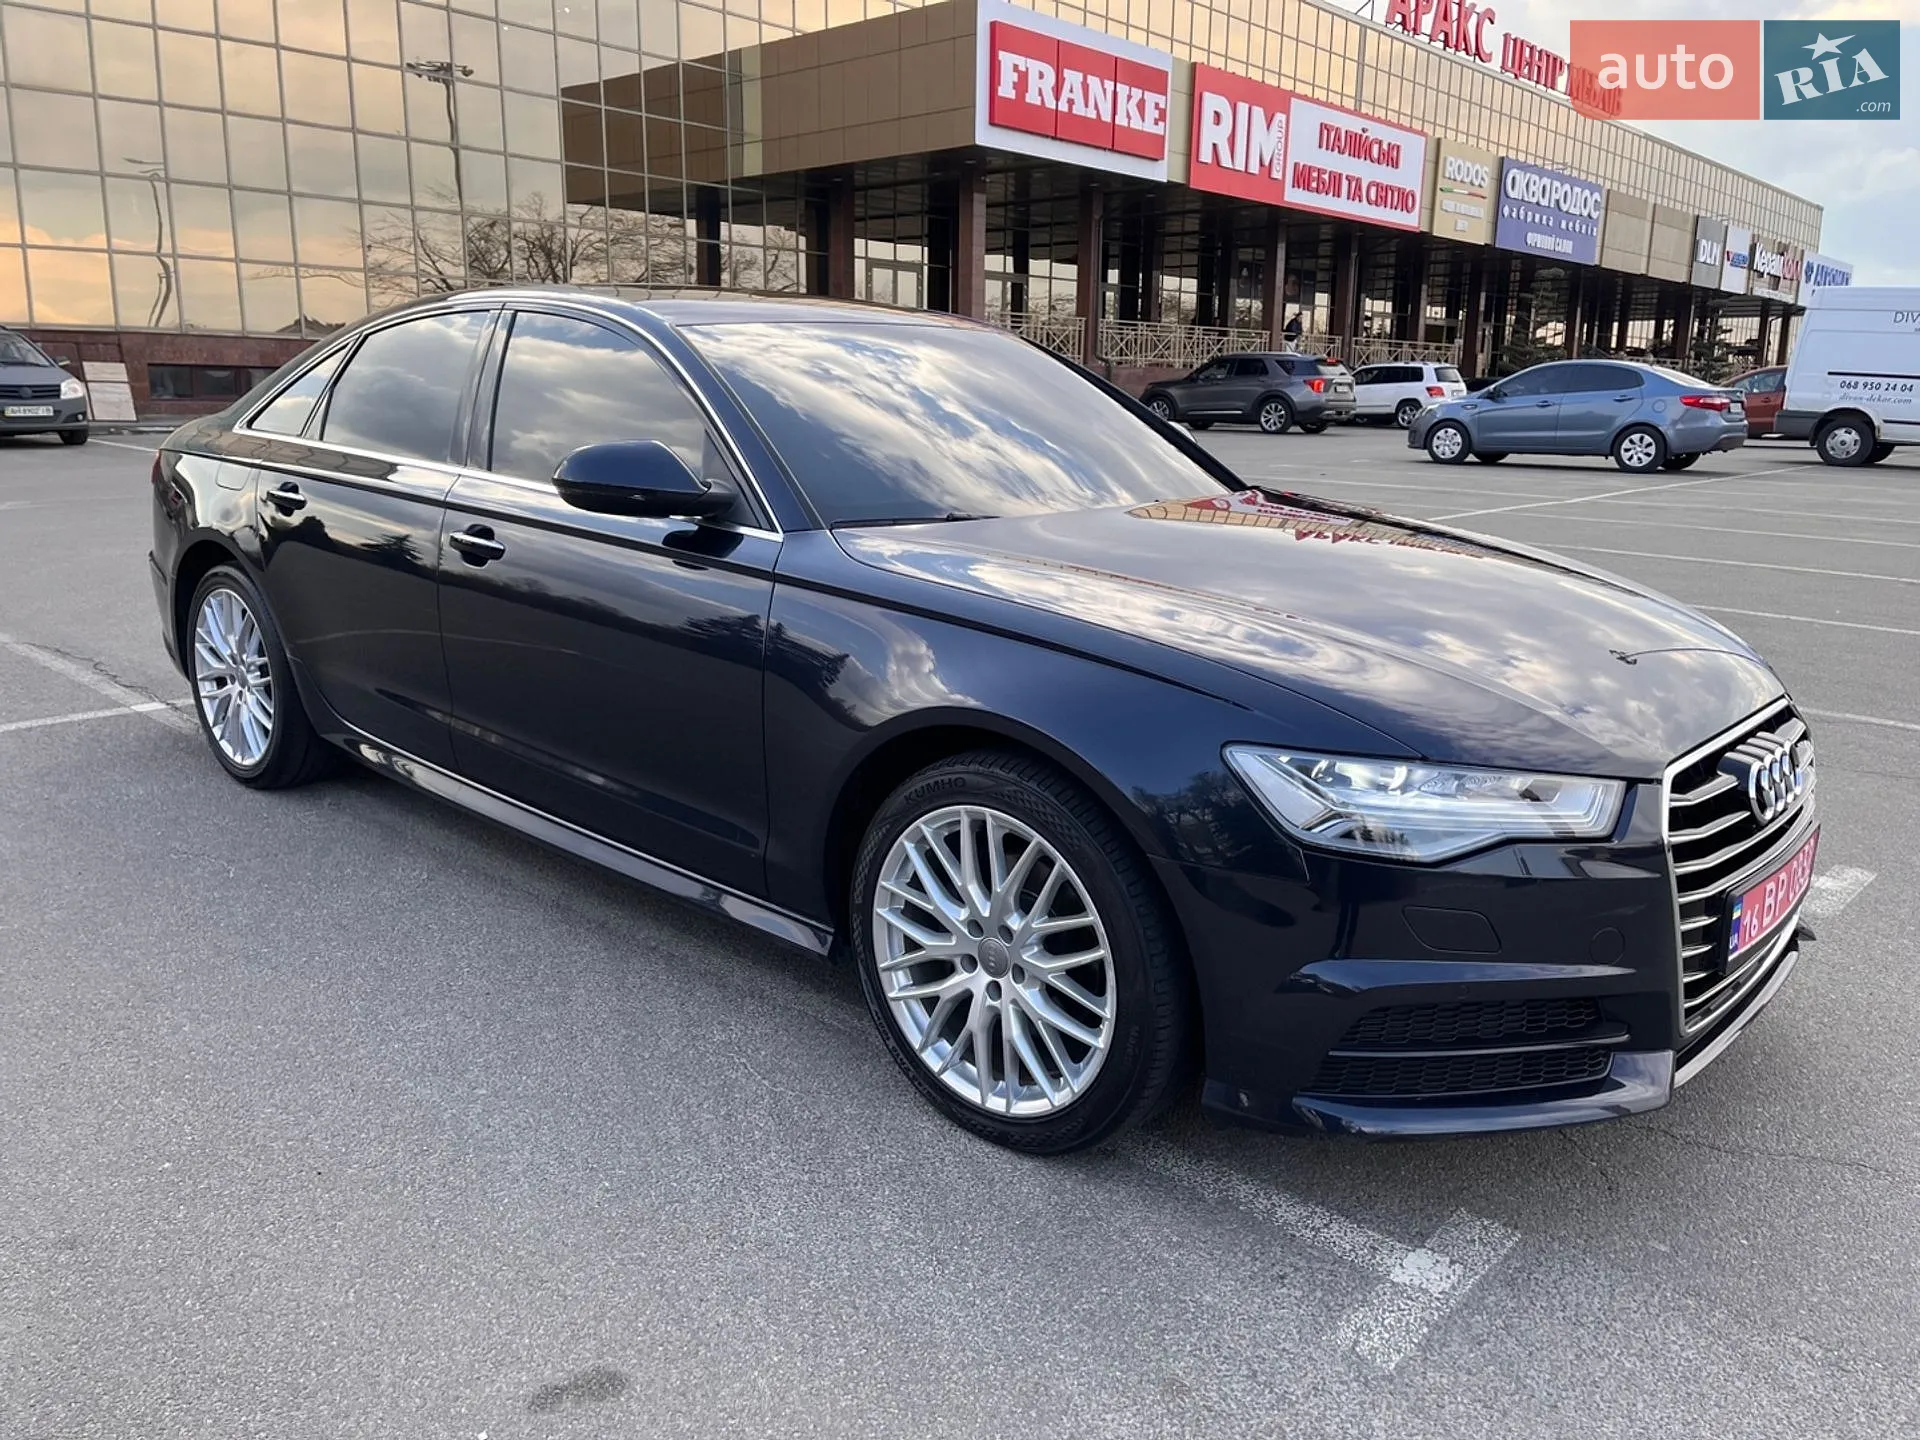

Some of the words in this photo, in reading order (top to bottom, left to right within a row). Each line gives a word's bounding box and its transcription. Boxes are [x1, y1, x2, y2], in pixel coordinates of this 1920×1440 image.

[1501, 32, 1565, 90] ЦЕНТР
[998, 51, 1166, 136] FRANKE
[1198, 91, 1287, 181] RIM
[1274, 118, 1286, 174] GROUP
[1318, 121, 1402, 169] ІТАЛІЙСЬКІ
[1292, 161, 1343, 199] МЕБЛІ
[1345, 174, 1364, 204] ТА
[1366, 179, 1417, 215] СВІТЛО
[1444, 155, 1489, 188] RODOS
[1840, 380, 1859, 390] 068
[1862, 381, 1881, 391] 950
[1885, 382, 1898, 392] 24
[1900, 383, 1914, 393] 04
[903, 776, 967, 801] KUMHO
[1743, 903, 1759, 942] 16
[1762, 870, 1787, 928] BP
